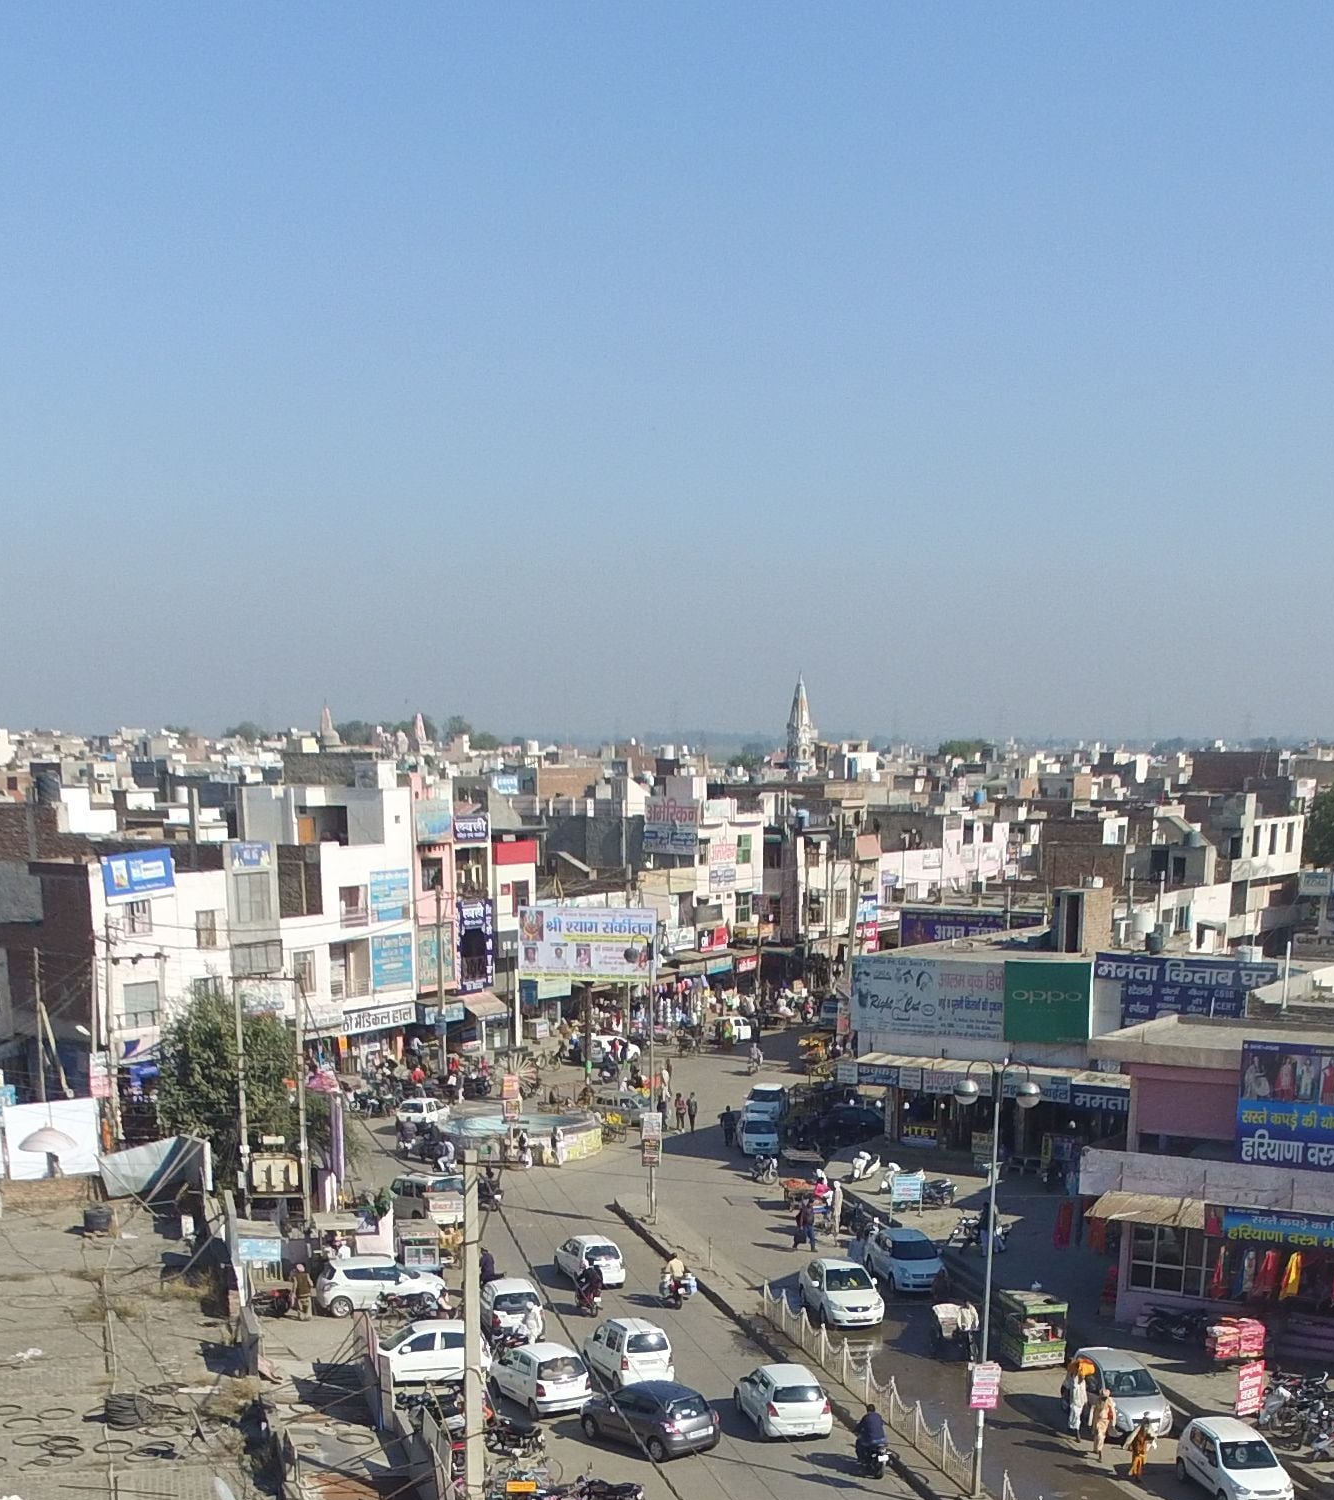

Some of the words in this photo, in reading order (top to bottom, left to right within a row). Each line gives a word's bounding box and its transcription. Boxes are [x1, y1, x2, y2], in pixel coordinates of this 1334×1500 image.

[1097, 960, 1159, 982] ममता
[1164, 960, 1236, 986] किताब
[902, 1125, 937, 1137] HTET
[1241, 1128, 1305, 1163] हरियाणा
[1228, 1225, 1283, 1243] हरियाणा
